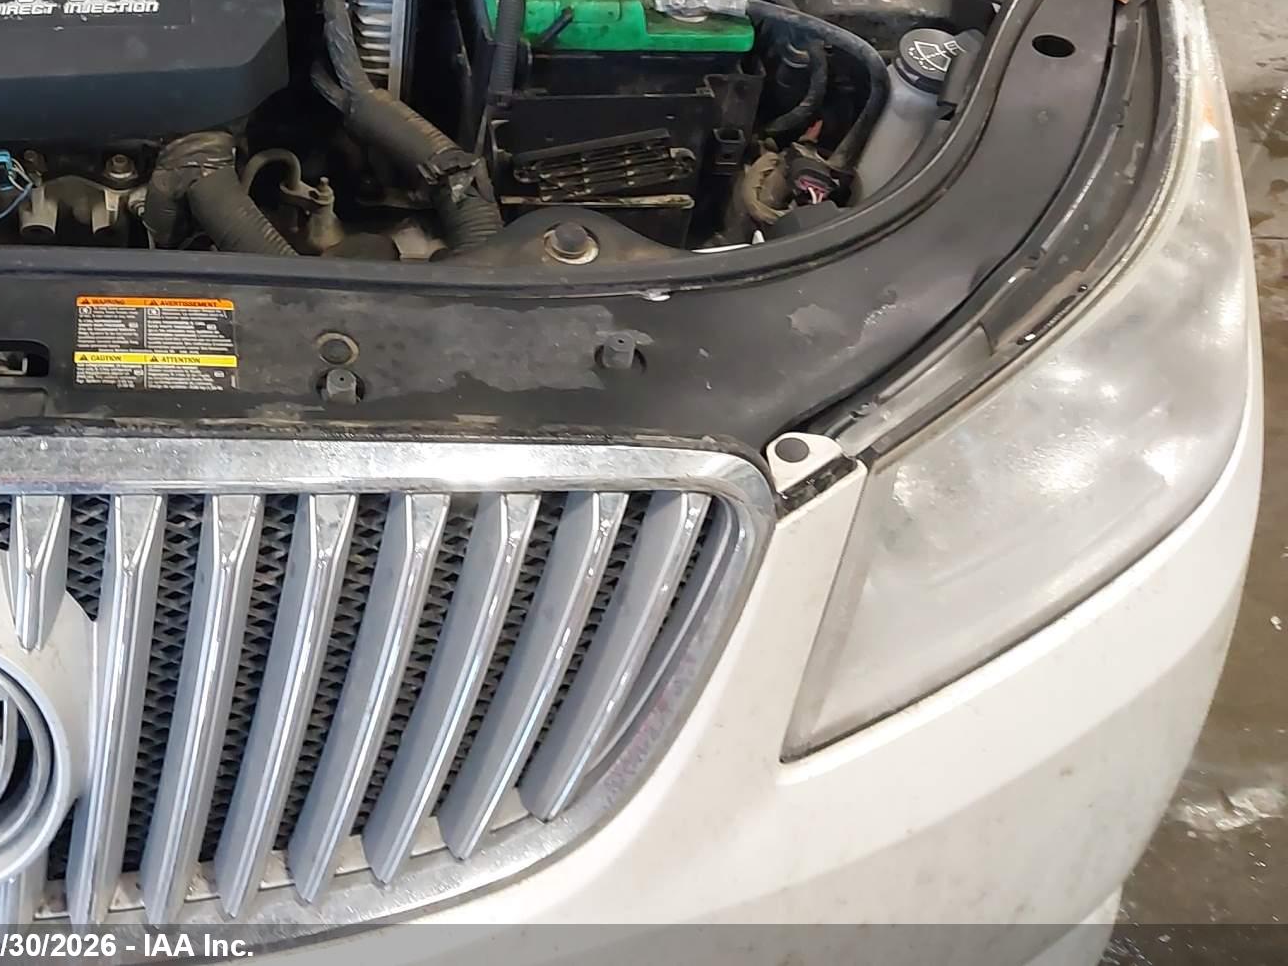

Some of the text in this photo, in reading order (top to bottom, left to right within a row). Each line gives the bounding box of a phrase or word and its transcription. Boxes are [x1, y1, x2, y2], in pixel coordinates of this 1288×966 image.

[64, 1, 159, 14] INJECTION
[159, 300, 218, 308] AVERTISSEMENT
[91, 354, 122, 362] CAUTION
[161, 356, 201, 364] ATTENTION
